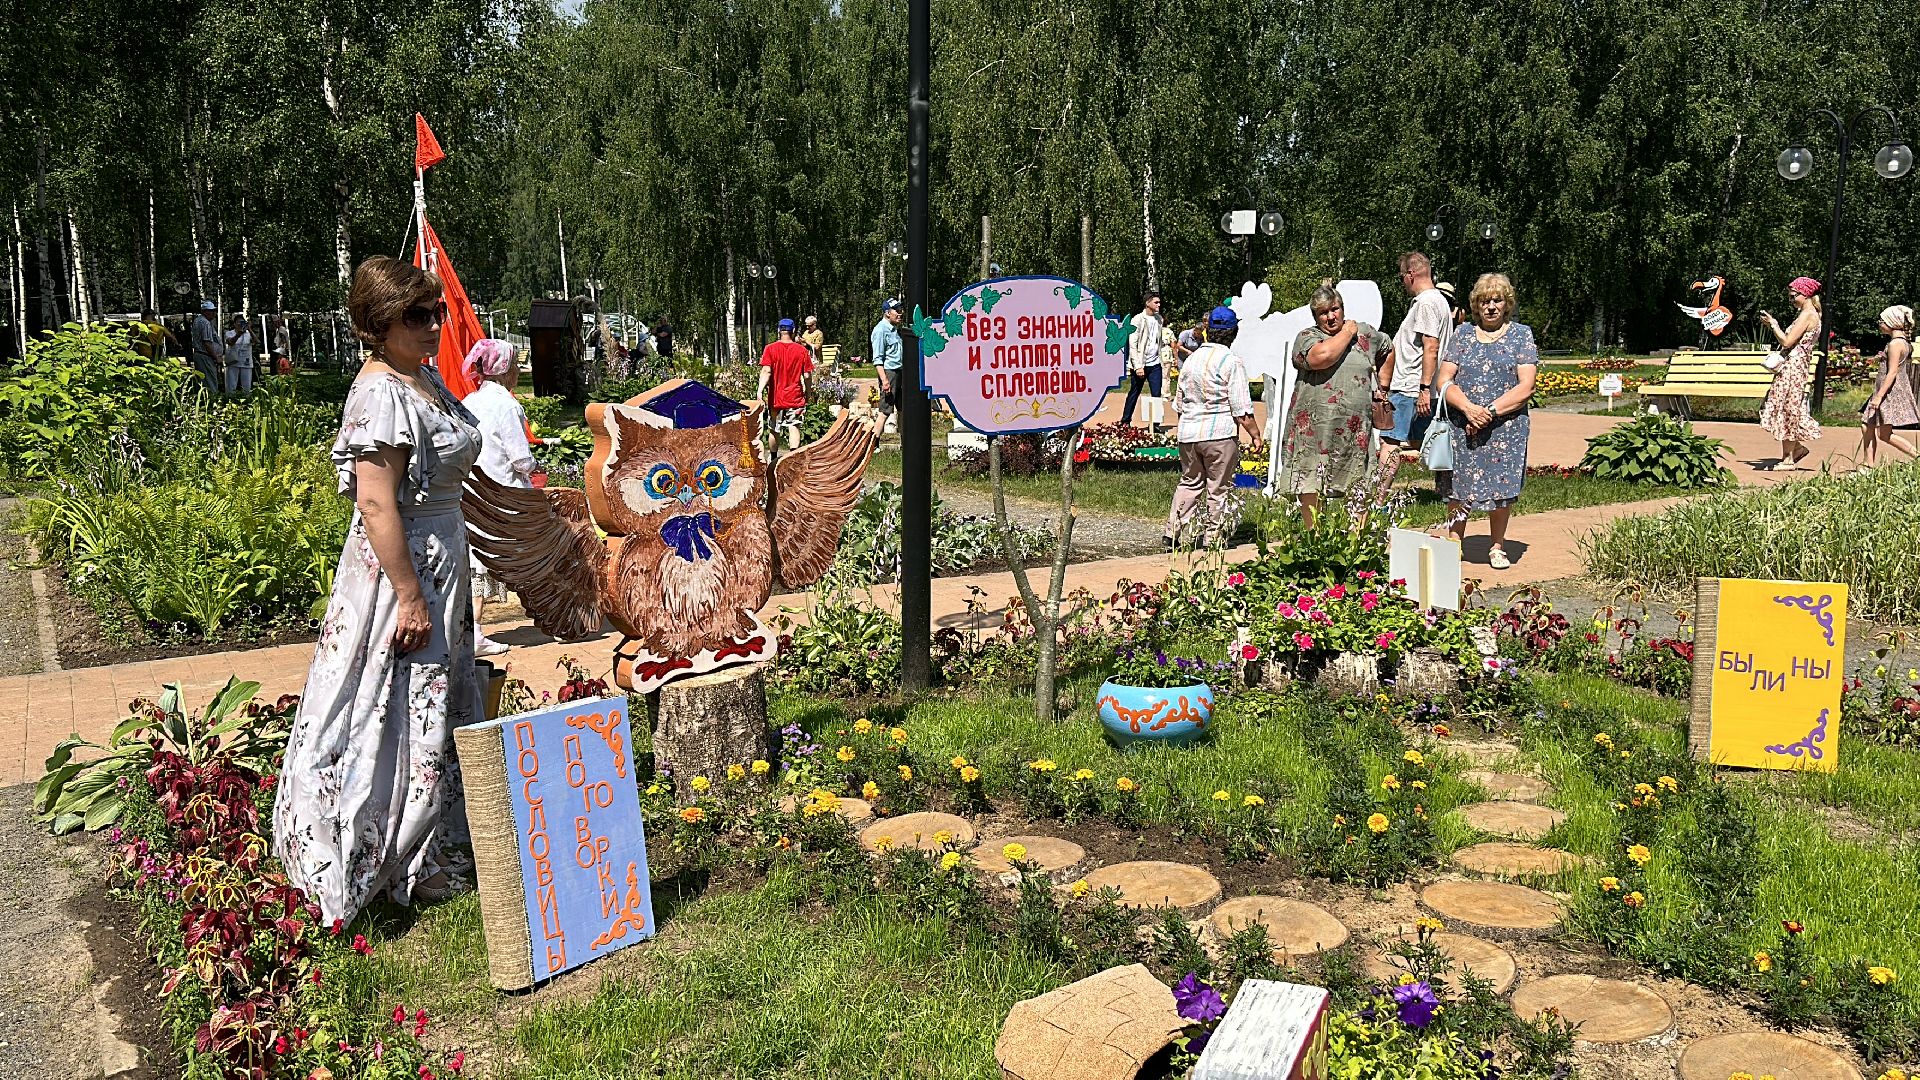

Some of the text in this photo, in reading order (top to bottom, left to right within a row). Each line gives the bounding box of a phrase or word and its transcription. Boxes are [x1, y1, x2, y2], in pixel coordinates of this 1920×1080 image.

[966, 311, 1094, 341] Без знаний
[968, 343, 1094, 370] и лаптя не
[981, 367, 1093, 399] сплетёшь.
[514, 721, 567, 972] ПОСЛОВИЦЫ
